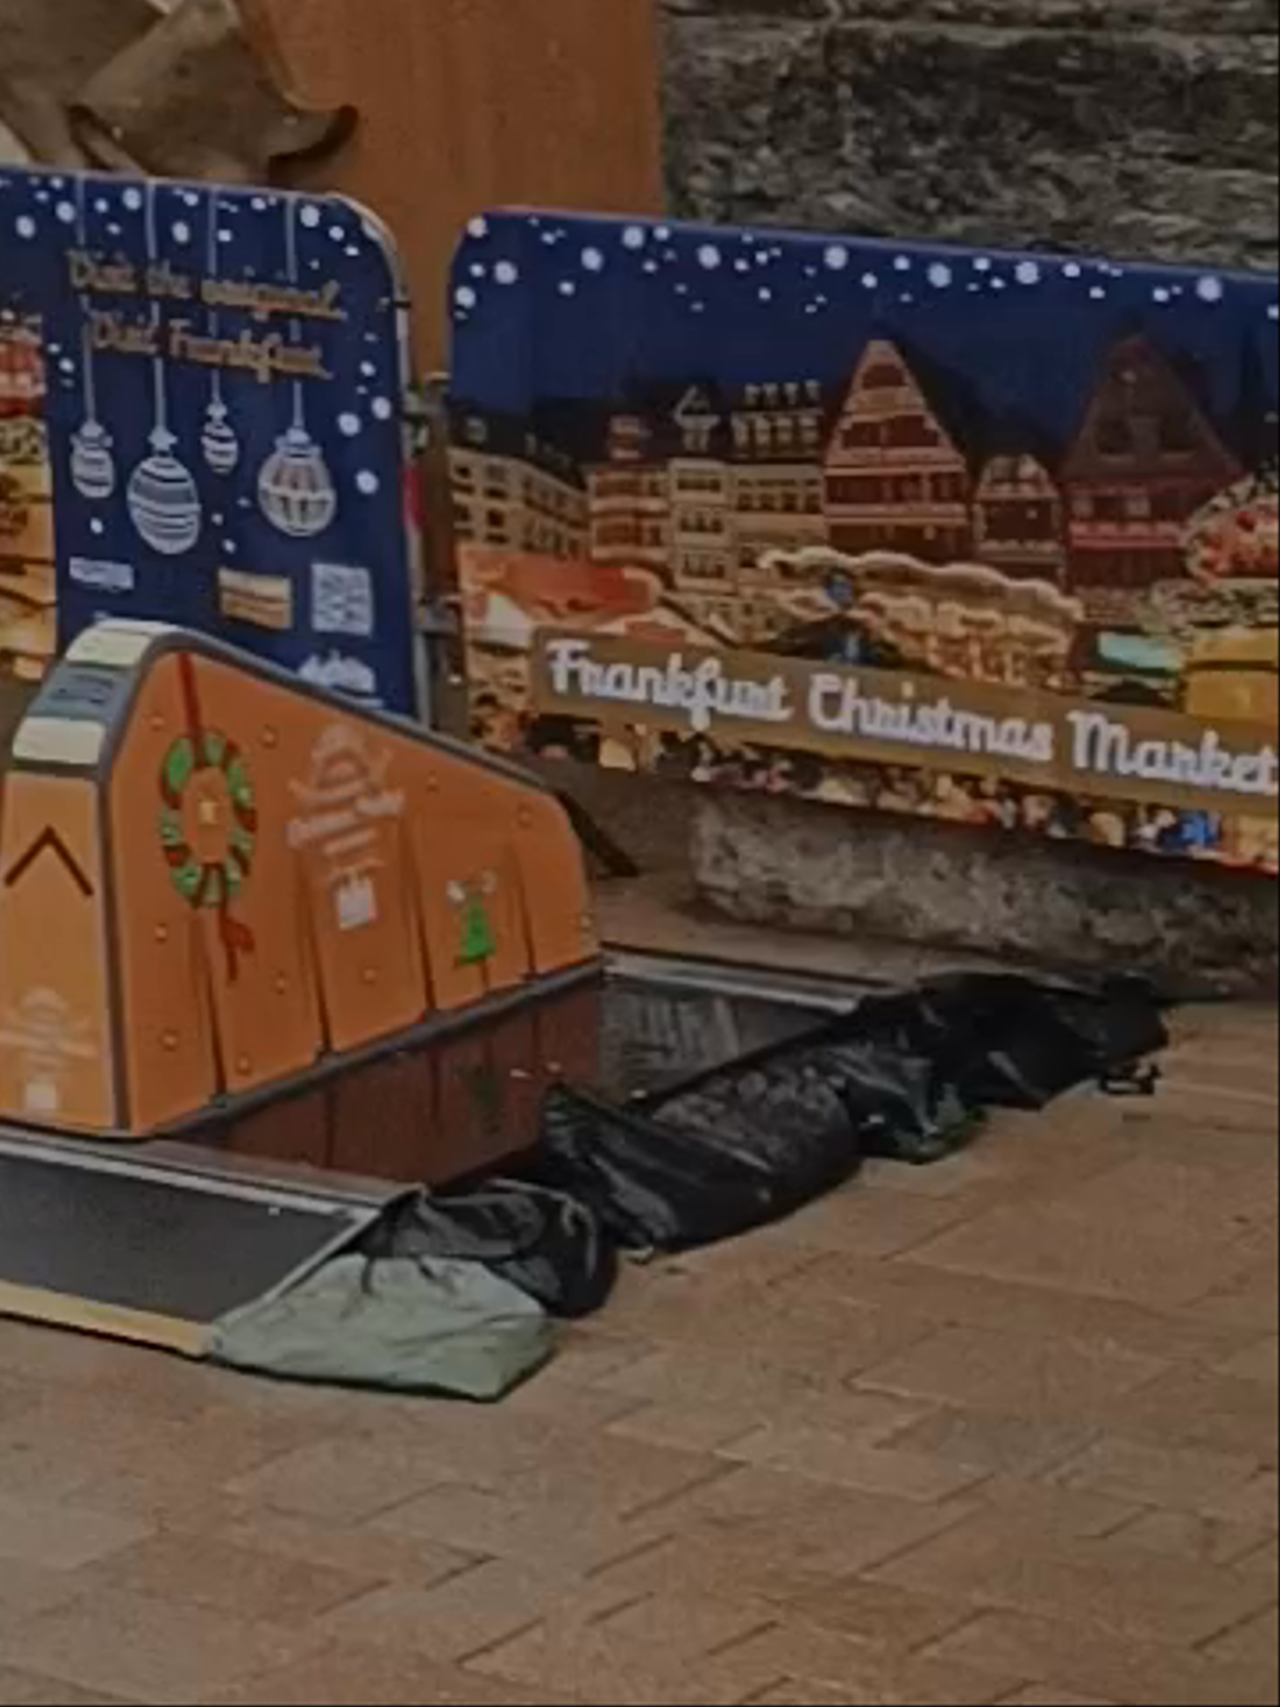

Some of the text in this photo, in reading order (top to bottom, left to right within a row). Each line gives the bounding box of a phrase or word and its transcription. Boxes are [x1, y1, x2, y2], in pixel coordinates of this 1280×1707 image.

[545, 637, 1279, 796] Frankfurt Christmas Market
